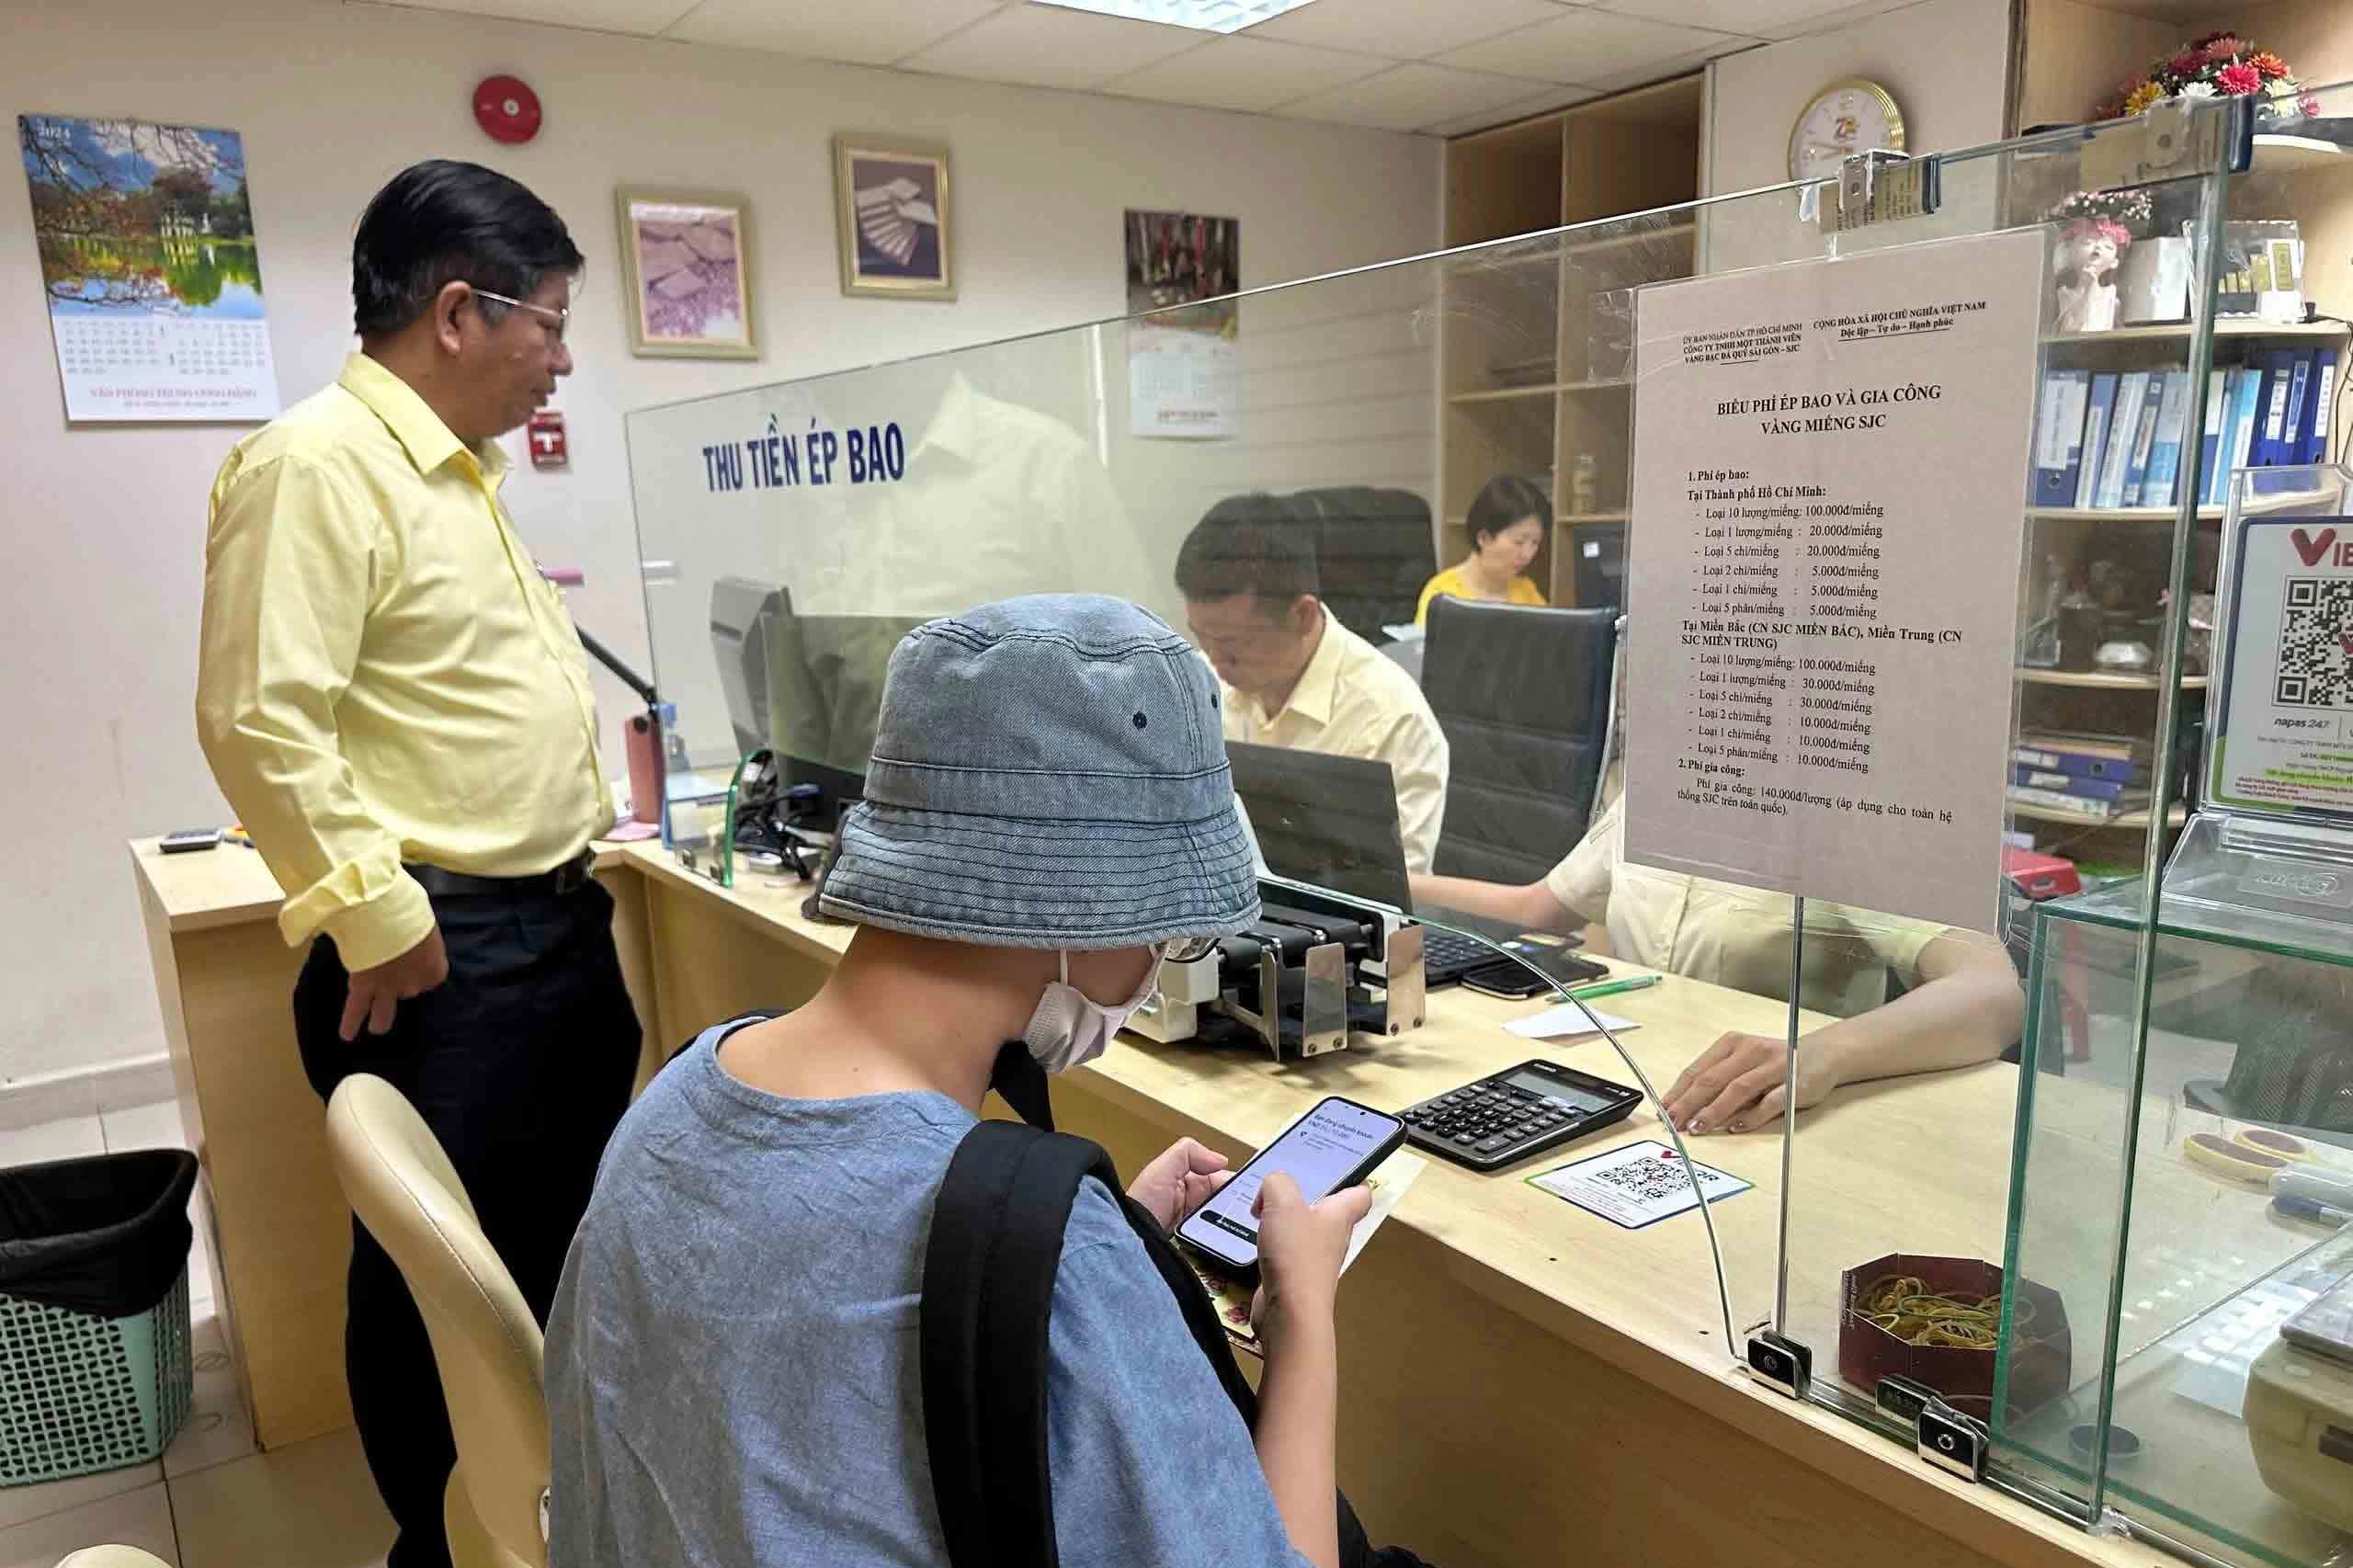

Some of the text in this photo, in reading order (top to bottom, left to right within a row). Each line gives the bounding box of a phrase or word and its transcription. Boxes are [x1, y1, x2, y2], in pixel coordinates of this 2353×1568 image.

[1813, 301, 1985, 329] CỘNG HÒA XÃ HỘI CHỦ NGHĨA VIỆT NAM
[1840, 328, 1855, 337] Độc
[1857, 327, 1868, 337] lập
[1878, 324, 1888, 333] Tự
[1890, 323, 1900, 332] do
[1909, 320, 1931, 330] Hạnh
[1933, 317, 1953, 328] phúc
[1717, 383, 1941, 415] BIỂU PHÍ ÉP BAO VÀ GIA CÔNG
[1761, 414, 1886, 435] VÀNG MIẾNG SJC
[702, 413, 904, 492] THU TIỀN ÉP BAO
[1688, 470, 1749, 483] 1. Phí ép bao:
[1688, 485, 1826, 503] Tại Thành phố Hồ Chí Minh:
[1706, 507, 1725, 521] Loại
[1805, 502, 1883, 517] 100.000đ/miếng
[1705, 527, 1724, 540] Loại
[1809, 522, 1882, 539] 20.000đ/miếng
[1704, 546, 1723, 559] Loại
[1807, 542, 1880, 559] 20.000đ/miếng
[1703, 565, 1722, 577] Loại
[1812, 563, 1879, 580] 5.000đ/miếng
[1702, 584, 1722, 597] Loại
[1811, 584, 1879, 600] 5.000đ/miếng
[1701, 603, 1722, 614] Loại
[1810, 604, 1876, 619] 5.000đ/miếng
[1682, 619, 1961, 643] Tại Miền Bắc (CN SJC MIỀN BẮC), Miền Trung (CN
[1682, 634, 1778, 650] SJC MIỀN TRUNG)
[1700, 653, 1720, 665] Loại
[1799, 658, 1875, 676] 100.000đ/miếng
[1699, 673, 1720, 684] Loại
[1802, 678, 1874, 696] 30.000đ/miếng
[1699, 691, 1719, 702] Loại
[1801, 697, 1872, 715] 30.000đ/miếng
[1699, 708, 1718, 720] Loại
[1801, 717, 1871, 735] 10.000đ/miếng
[1699, 726, 1717, 738] Loại
[1800, 735, 1870, 755] 10.000đ/miếng
[1678, 758, 1745, 777] 2. Phí gia công:
[1698, 743, 1717, 756] Loại
[1798, 755, 1869, 774] 10.000đ/miếng
[1697, 778, 1952, 823] Phí gia công: 140.000đ/lượng (áp dụng cho toàn hệ
